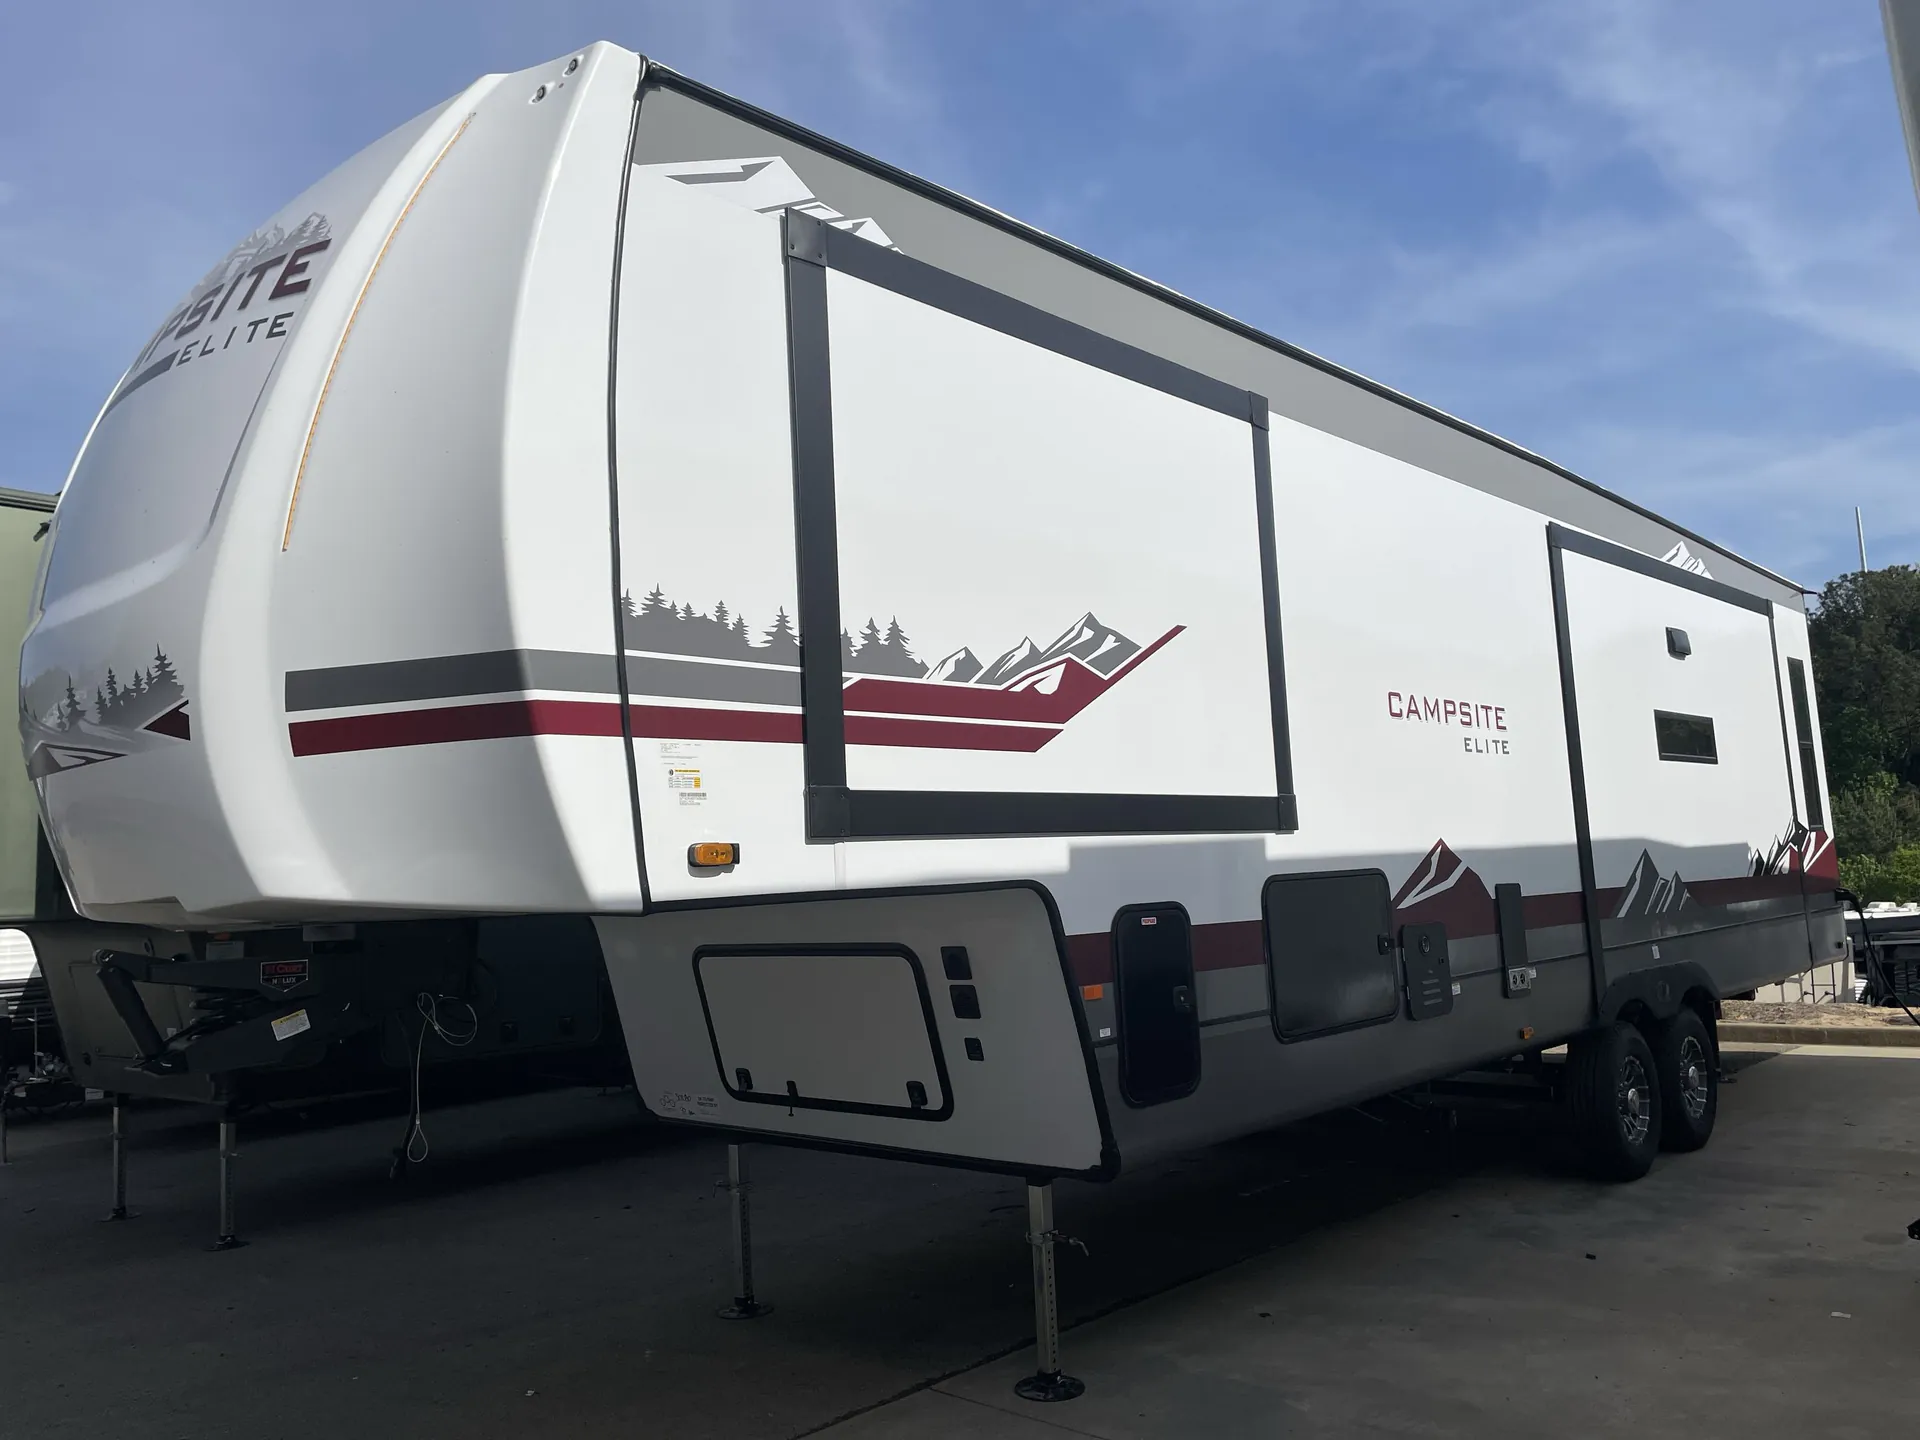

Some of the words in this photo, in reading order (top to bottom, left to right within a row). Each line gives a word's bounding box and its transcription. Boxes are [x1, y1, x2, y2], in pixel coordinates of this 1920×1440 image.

[176, 311, 294, 366] ELITE
[1387, 691, 1508, 731] CAMPSITE
[1463, 737, 1510, 755] ELITE
